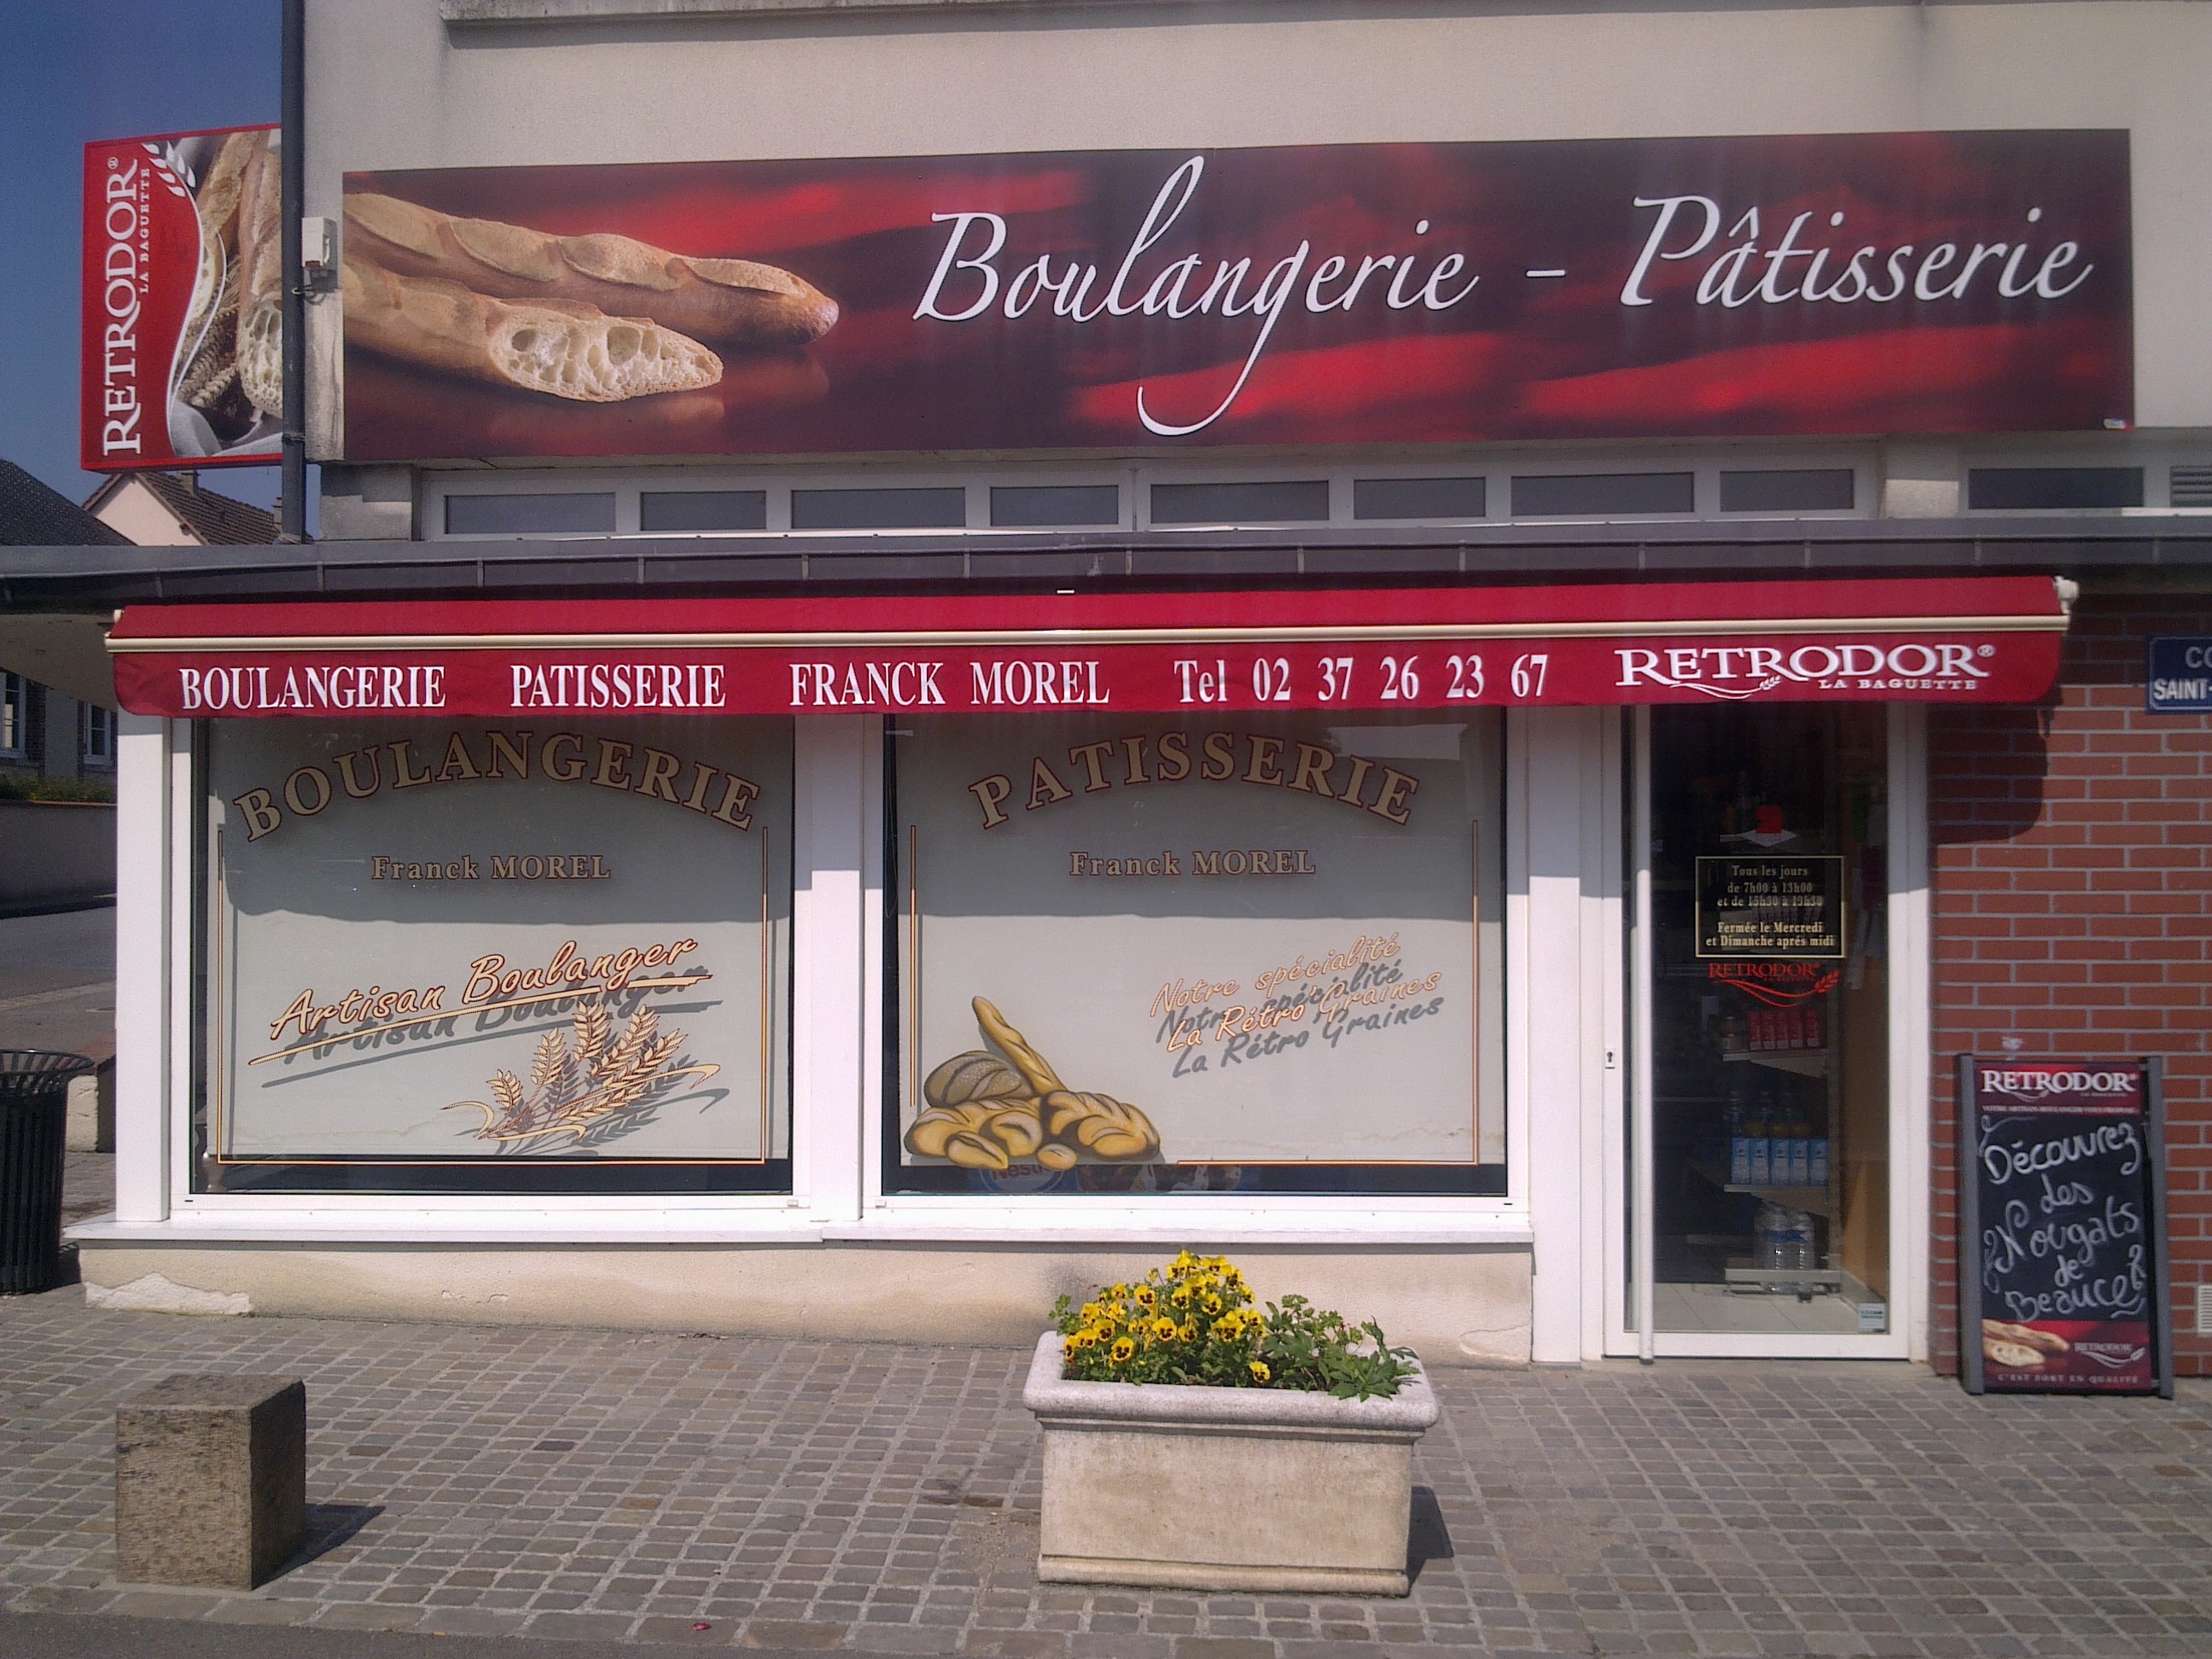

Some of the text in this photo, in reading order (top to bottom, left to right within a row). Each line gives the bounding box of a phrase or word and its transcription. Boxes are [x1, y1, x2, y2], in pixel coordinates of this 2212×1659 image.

[138, 167, 151, 294] LA BAGUETTE
[913, 156, 1479, 436] Boulangerie
[1621, 195, 2093, 307] Pâtisserie
[179, 654, 1549, 710] BOULANGERIE PATISSERIE FRANCK MOREL Tel 02 37 26 23 67
[1818, 678, 1977, 690] LA BAGUETTE
[233, 730, 761, 842] BOULANGERIE
[968, 731, 1420, 830] PATISSERIE
[371, 854, 612, 881] Franck MOREL
[1068, 849, 1316, 876] Franck MOREL
[1732, 864, 1808, 880] Tous les jours
[1717, 897, 1728, 907] et
[1732, 896, 1744, 907] de
[1727, 882, 1813, 894] de 7h00 à 13h00
[1705, 936, 1717, 946] et
[1720, 934, 1774, 946] Dimanche
[1809, 934, 1835, 946] midi
[1717, 921, 1824, 934] Fermée le Mercredi
[270, 938, 698, 1040] Artisan Boulanger
[1150, 931, 1400, 1017] Notre spécialité
[1166, 1019, 1203, 1052] La
[1983, 1121, 2143, 1185] Découvrez
[1994, 1196, 2140, 1274] Nougats
[2054, 1254, 2085, 1288] de
[2005, 1274, 2140, 1323] Beauce
